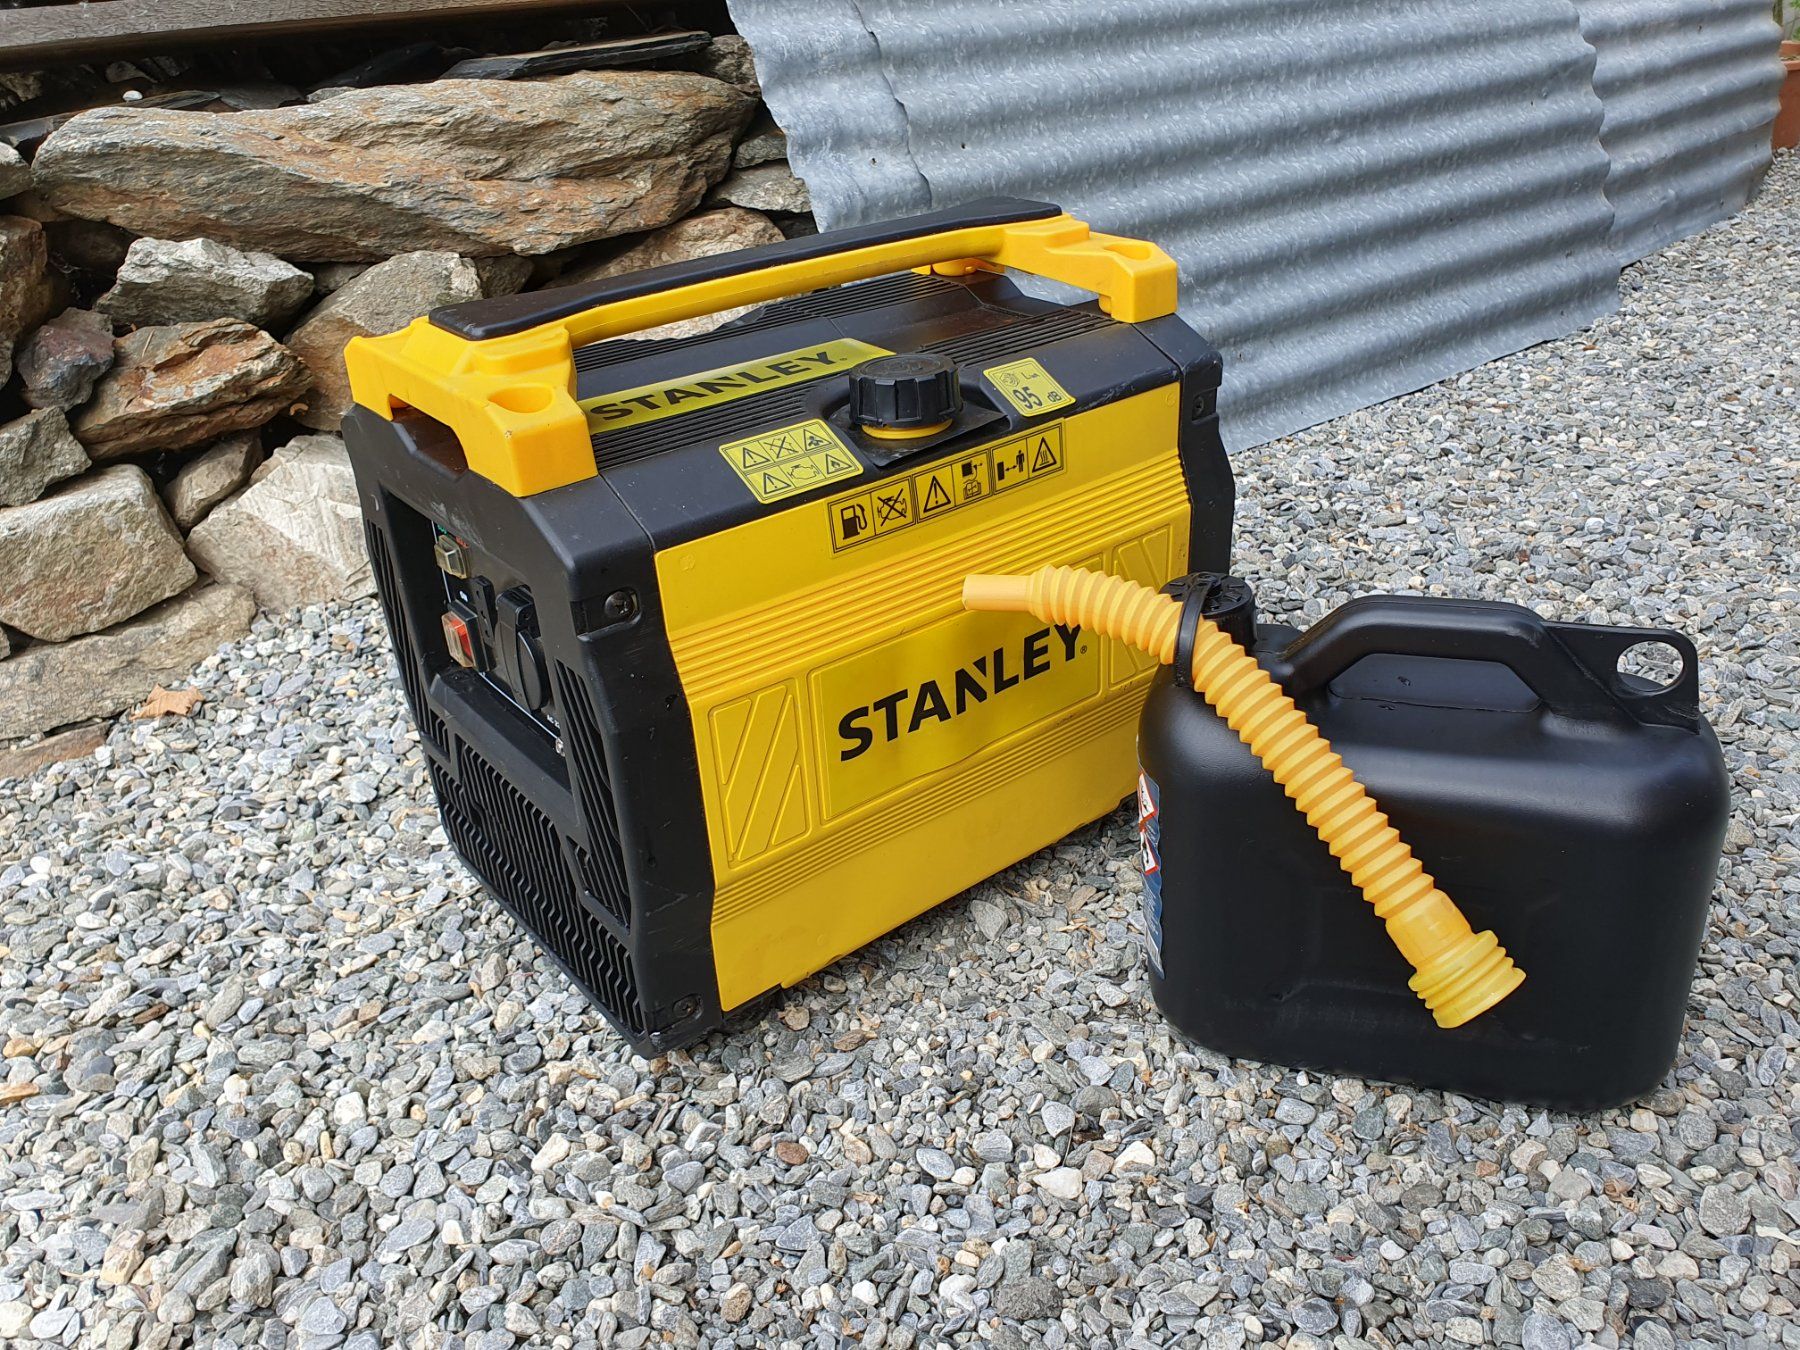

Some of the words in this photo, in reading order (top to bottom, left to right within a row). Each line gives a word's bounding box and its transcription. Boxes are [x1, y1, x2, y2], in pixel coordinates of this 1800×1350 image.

[590, 351, 836, 421] STANLEY
[1012, 386, 1043, 409] 95
[838, 624, 1080, 761] STANLEY
